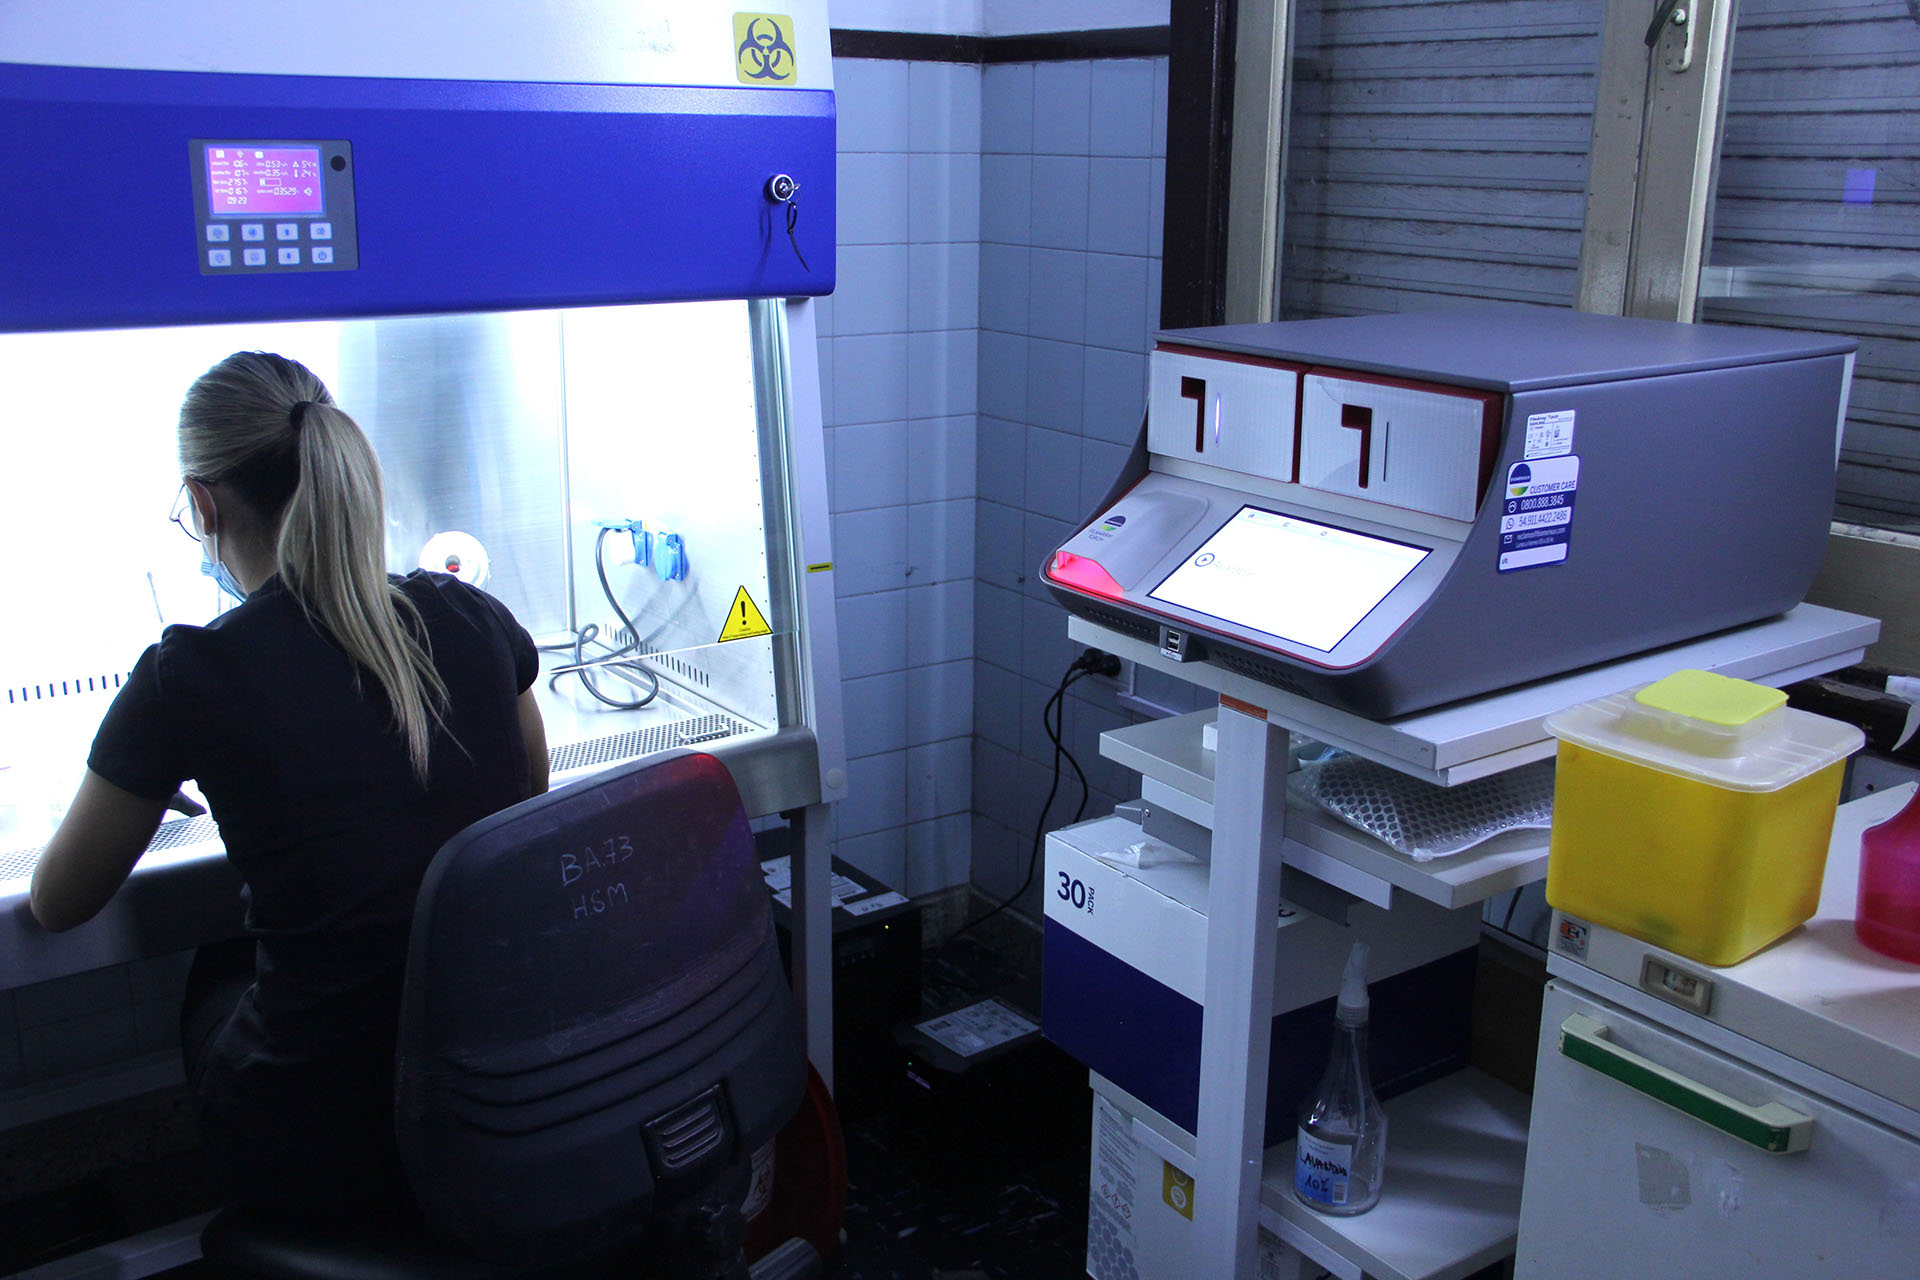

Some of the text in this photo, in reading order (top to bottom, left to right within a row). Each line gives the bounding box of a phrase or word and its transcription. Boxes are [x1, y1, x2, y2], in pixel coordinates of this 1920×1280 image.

[1529, 479, 1576, 495] CUSTOMER CARE
[1056, 871, 1096, 916] 30 PACK
[1304, 1174, 1330, 1193] 10%
